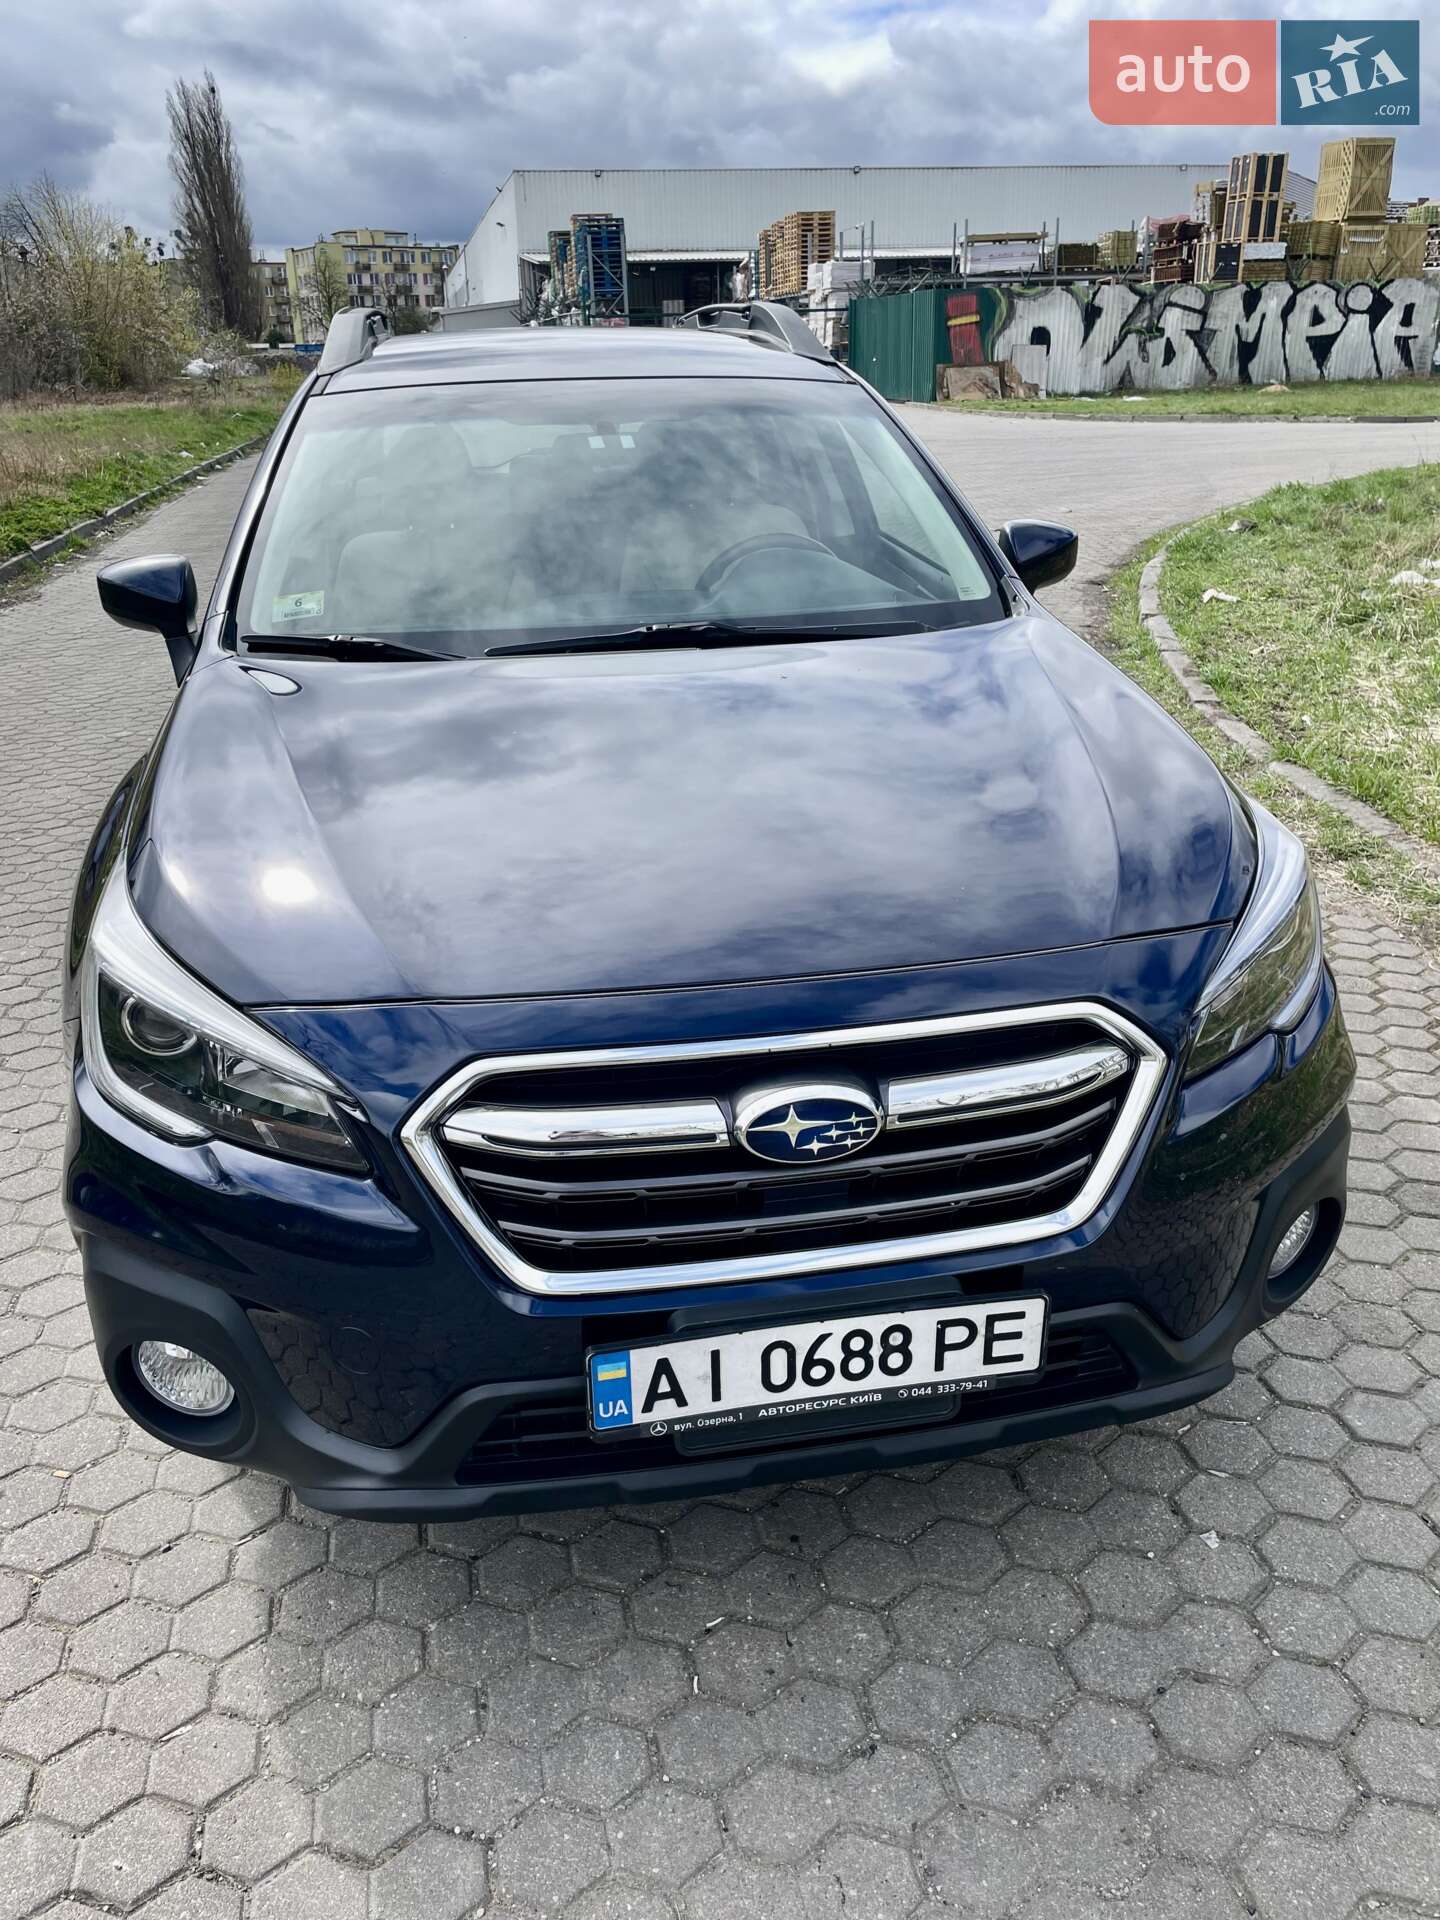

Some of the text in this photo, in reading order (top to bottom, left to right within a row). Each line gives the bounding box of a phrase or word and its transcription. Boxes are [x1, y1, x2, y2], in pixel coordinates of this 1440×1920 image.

[641, 1310, 1026, 1414] AI 0688 PE
[599, 1399, 629, 1418] UA
[674, 1422, 694, 1432] вул.
[697, 1414, 736, 1428] Озерна,
[758, 1397, 847, 1418] АВТОРЕСУРС
[850, 1391, 882, 1404] КИЇВ
[911, 1386, 932, 1397] 044
[937, 1379, 988, 1394] 333-79-41
